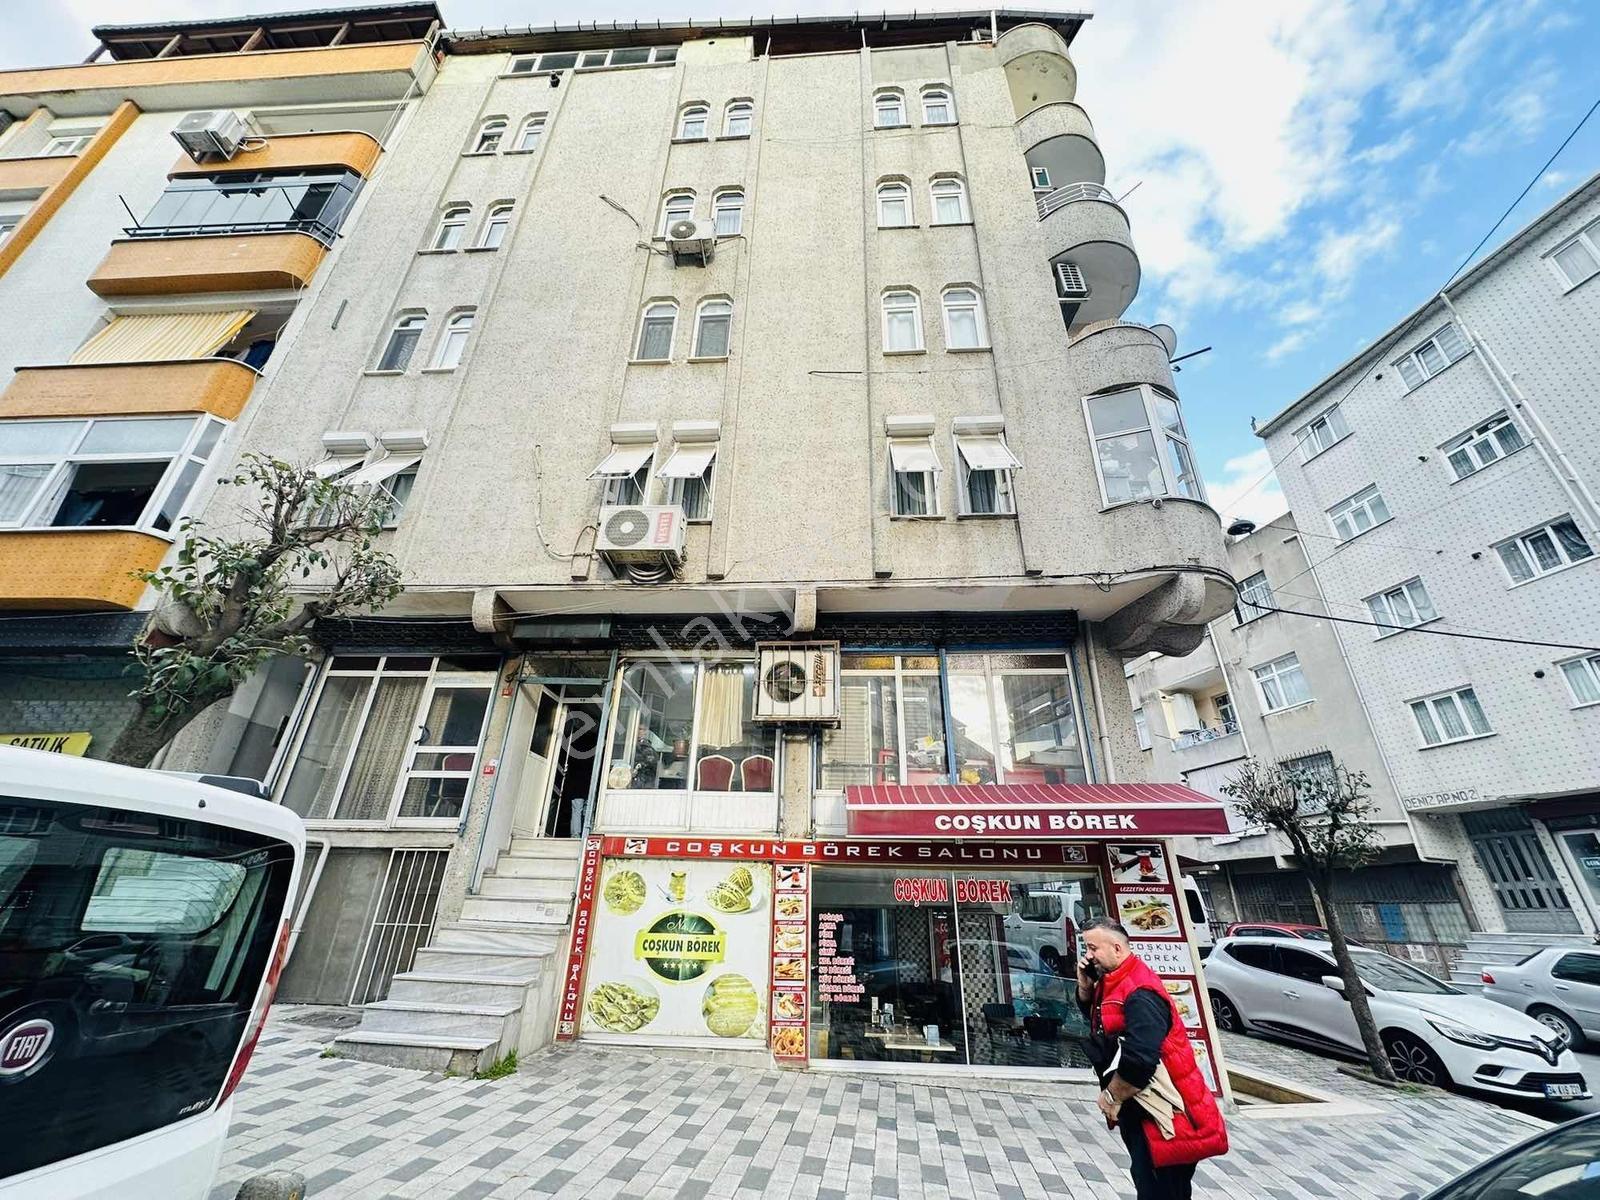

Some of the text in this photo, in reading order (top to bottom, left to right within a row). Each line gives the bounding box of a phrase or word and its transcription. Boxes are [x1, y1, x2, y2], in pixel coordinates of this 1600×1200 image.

[934, 811, 1138, 834] COŞKUN BÖREK
[666, 842, 1041, 859] COŞKUN BÖREK SALONU
[894, 875, 1013, 907] COŞKUN BÖREK
[574, 910, 588, 953] BÖREK
[642, 937, 720, 955] COŞKUN BÖREK
[4, 1034, 45, 1061] FIAT
